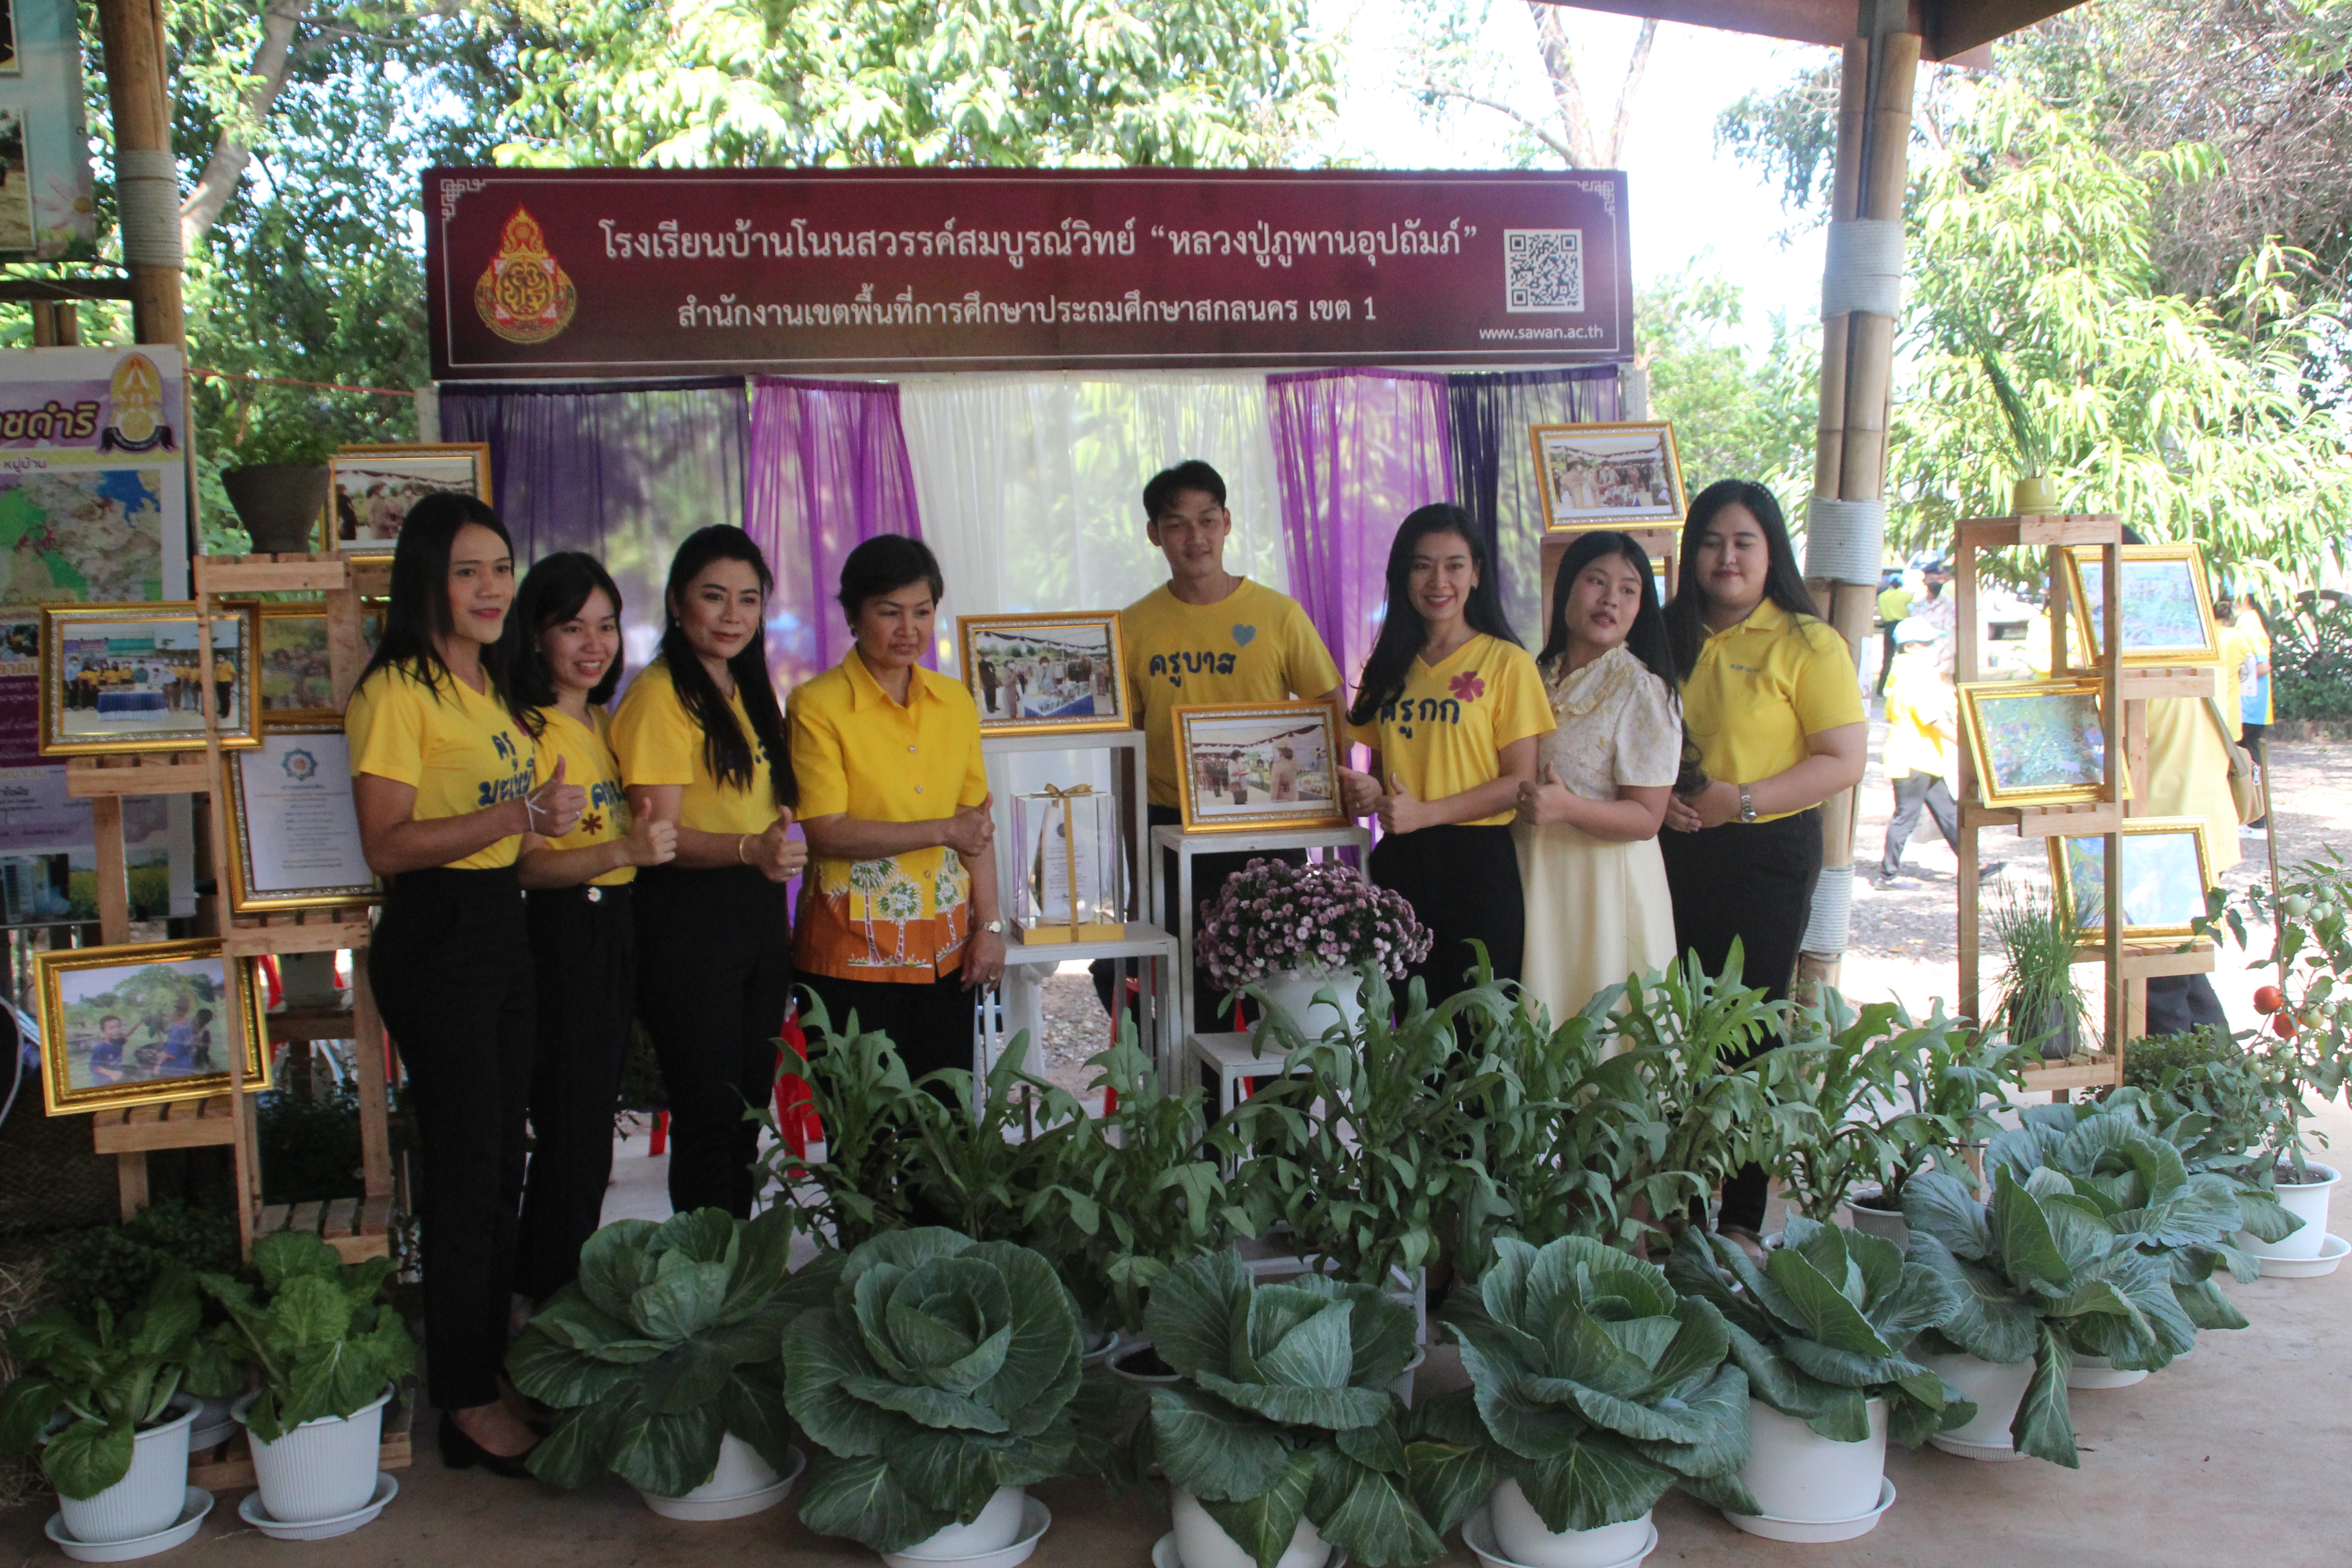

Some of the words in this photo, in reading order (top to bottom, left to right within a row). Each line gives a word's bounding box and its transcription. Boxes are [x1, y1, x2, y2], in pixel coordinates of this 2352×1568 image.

[598, 216, 1136, 269] โรงเรียนบ้านโนนสวรรค์สมบูรณ์วิทย์
[1150, 217, 1477, 268] “หลวงปู่ภูพานอุปถัมภ์”
[678, 282, 1298, 327] สำนักงานเขตพื้นที่การศึกษาประถมศึกษาสกลนคร
[1309, 299, 1351, 320] เขต
[1363, 296, 1377, 320] 1
[1479, 324, 1604, 340] www.sawan.ac.th
[1149, 651, 1236, 688] ครูบาส
